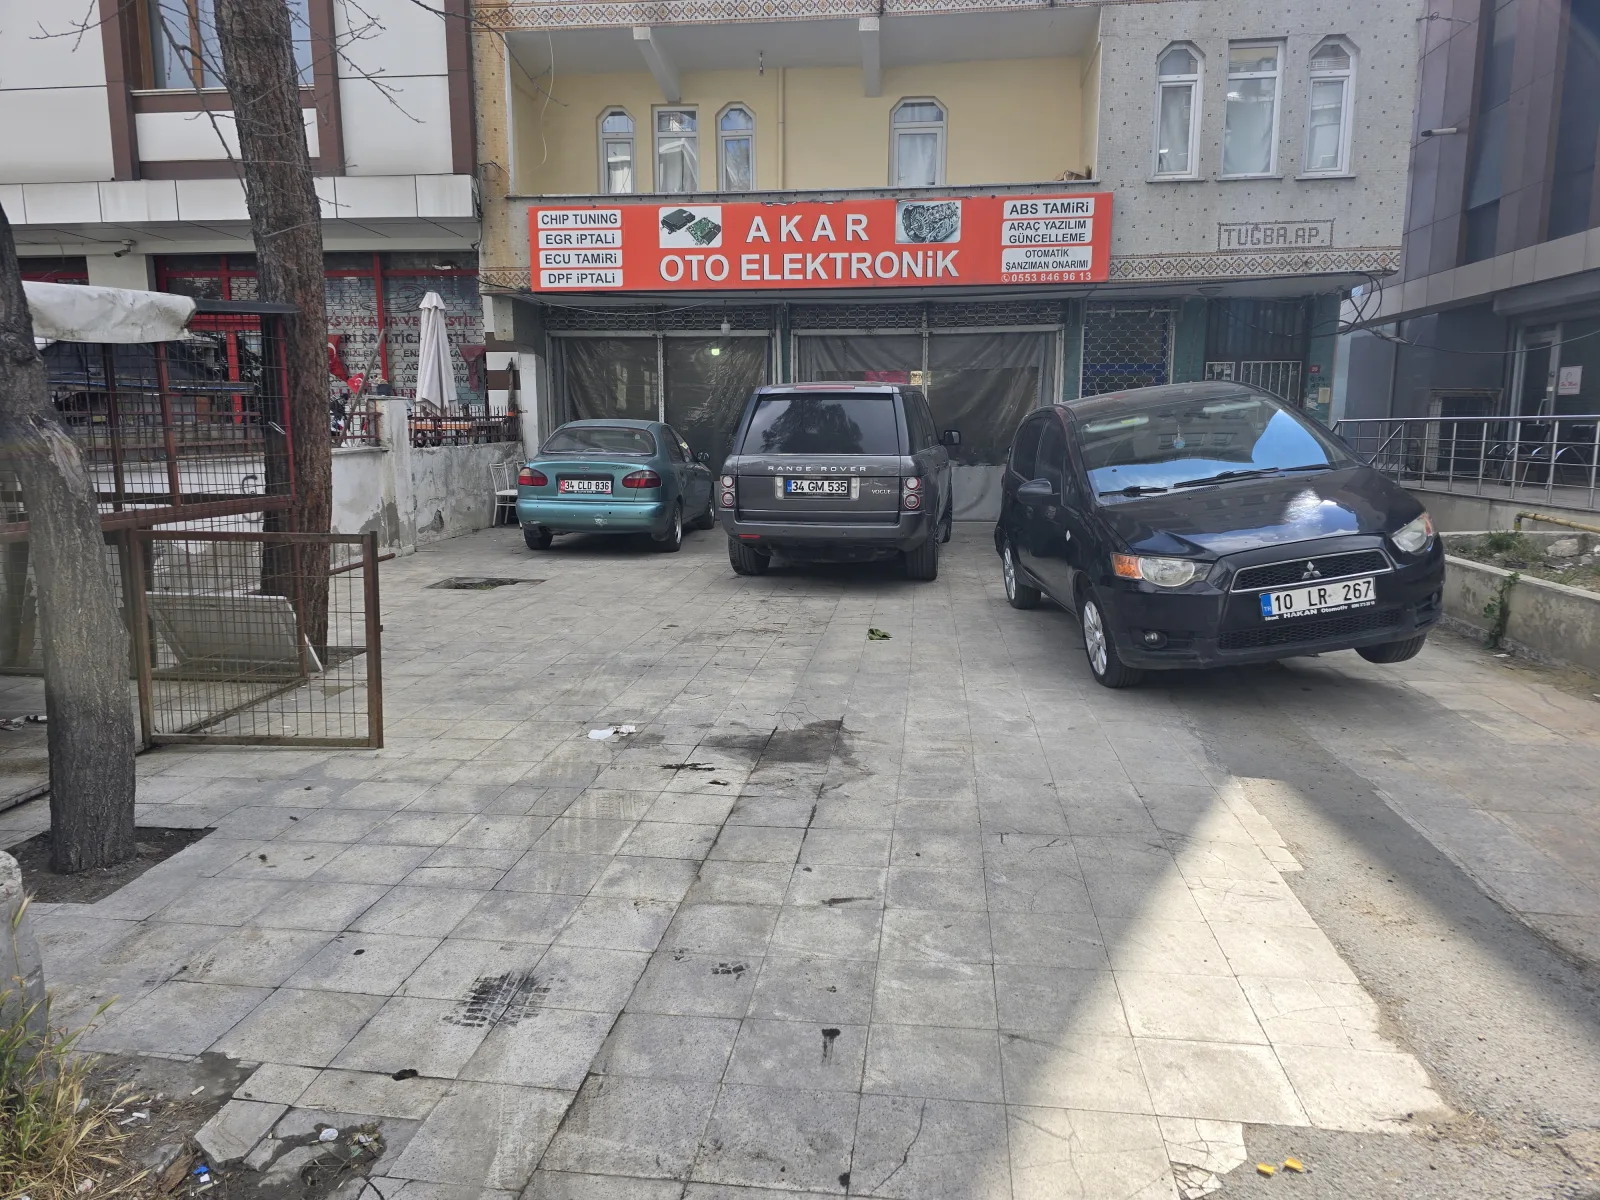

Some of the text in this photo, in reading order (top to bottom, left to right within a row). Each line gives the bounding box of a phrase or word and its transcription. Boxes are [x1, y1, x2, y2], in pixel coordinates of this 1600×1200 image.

[1009, 203, 1039, 215] ABS
[541, 213, 618, 225] CHIP TUNING
[745, 213, 869, 243] AKAR
[1008, 220, 1087, 233] ARAÇ YAZILIM
[545, 234, 572, 245] EGR
[1008, 231, 1086, 244] GÜNCELLEME
[1025, 247, 1069, 259] OTOMATİK
[544, 254, 571, 265] ECU
[659, 254, 729, 283] OTO
[1005, 260, 1088, 272] ŞANZIMAN ONARIMI
[548, 273, 572, 284] DPF
[1011, 271, 1092, 282] 0553 846 96 13
[565, 481, 574, 490] 34
[595, 481, 610, 490] 836
[792, 481, 847, 492] 34 GM 535
[1274, 593, 1293, 612] 10
[1308, 587, 1328, 607] LR
[1342, 580, 1372, 602] 267
[1283, 609, 1318, 619] HAKAN
